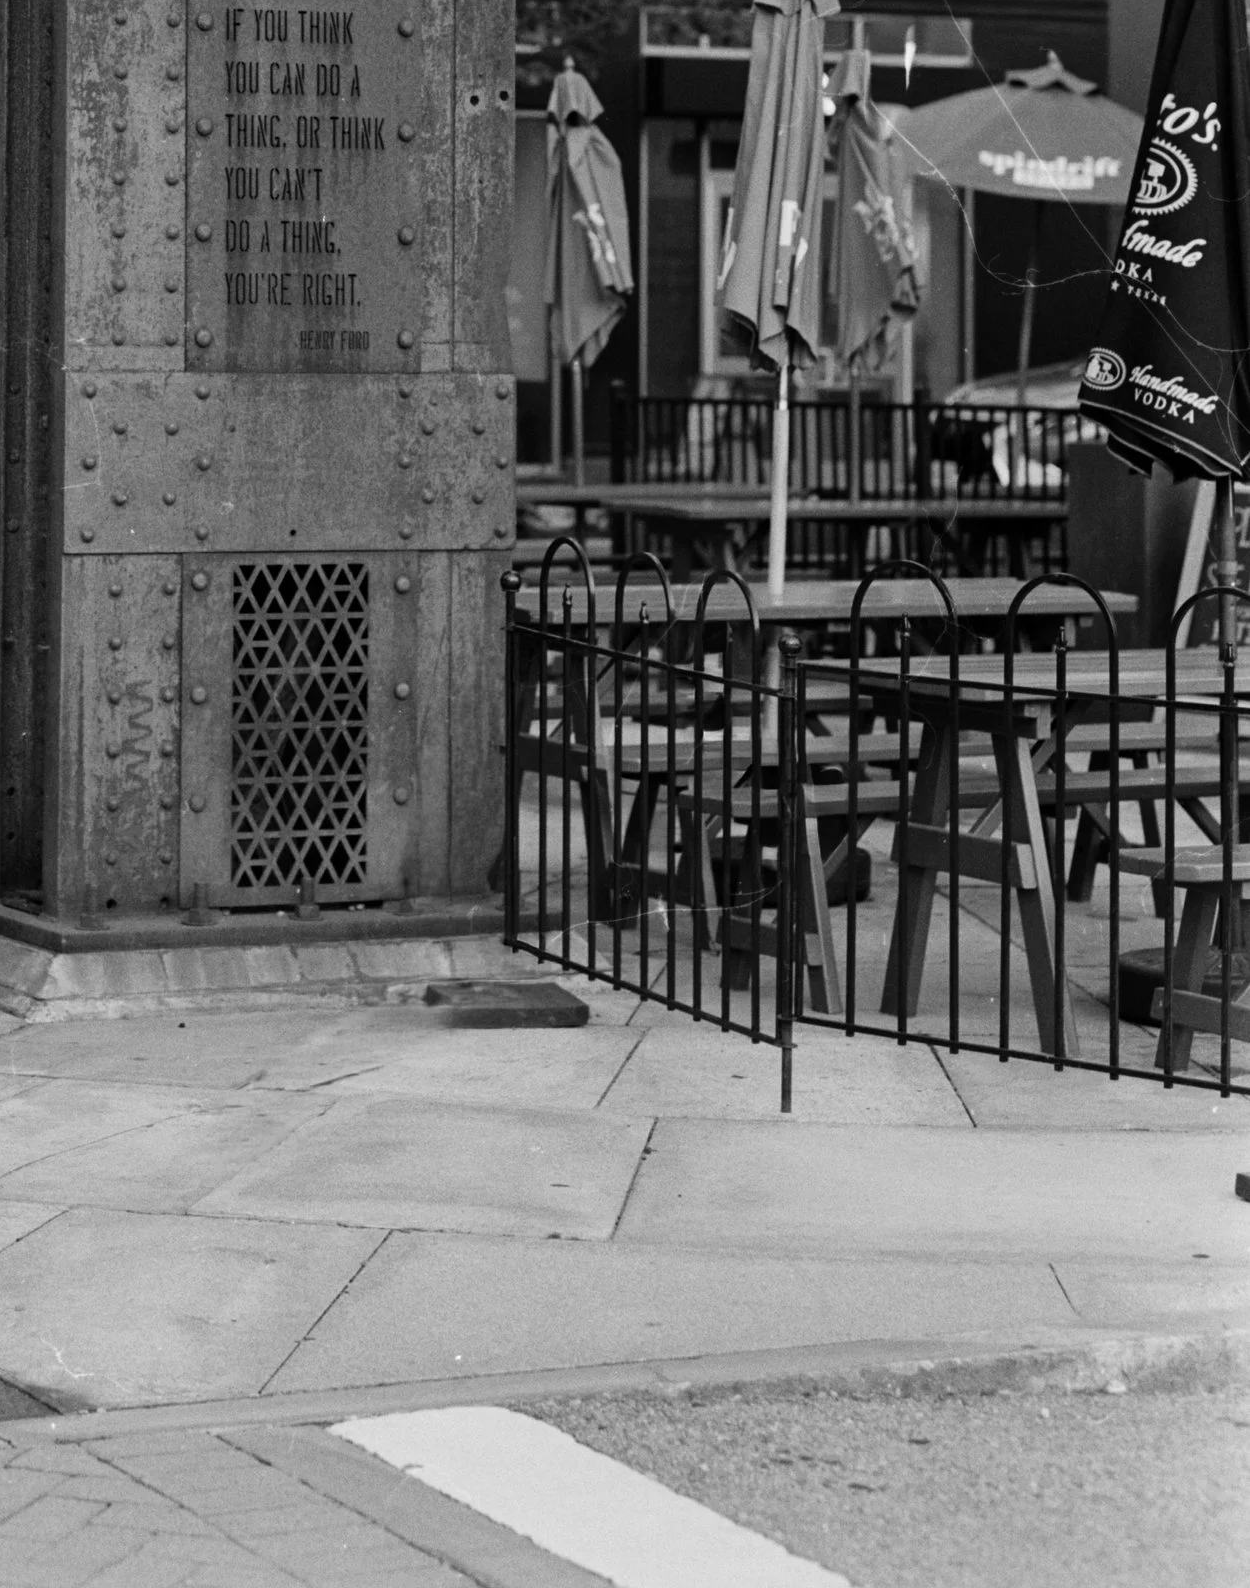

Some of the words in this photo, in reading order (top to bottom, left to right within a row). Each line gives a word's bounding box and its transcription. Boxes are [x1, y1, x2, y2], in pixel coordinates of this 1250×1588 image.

[225, 7, 245, 42] IF
[254, 9, 288, 42] YOU
[297, 10, 354, 45] THINK
[225, 61, 259, 94] YOU
[270, 62, 306, 96] CAN
[316, 64, 340, 97] DO
[350, 64, 361, 97] A
[297, 115, 321, 149] OR
[329, 116, 385, 151] THINK
[225, 166, 259, 200] YOU
[269, 167, 323, 201] CAN'T
[225, 219, 250, 253] DO
[260, 220, 271, 253] A
[280, 220, 342, 257] THING,
[225, 273, 292, 306] YOU'RE
[300, 330, 336, 350] HENRY
[340, 330, 370, 351] FORD
[1128, 364, 1220, 415] Handmade
[1133, 387, 1195, 425] VODKA
